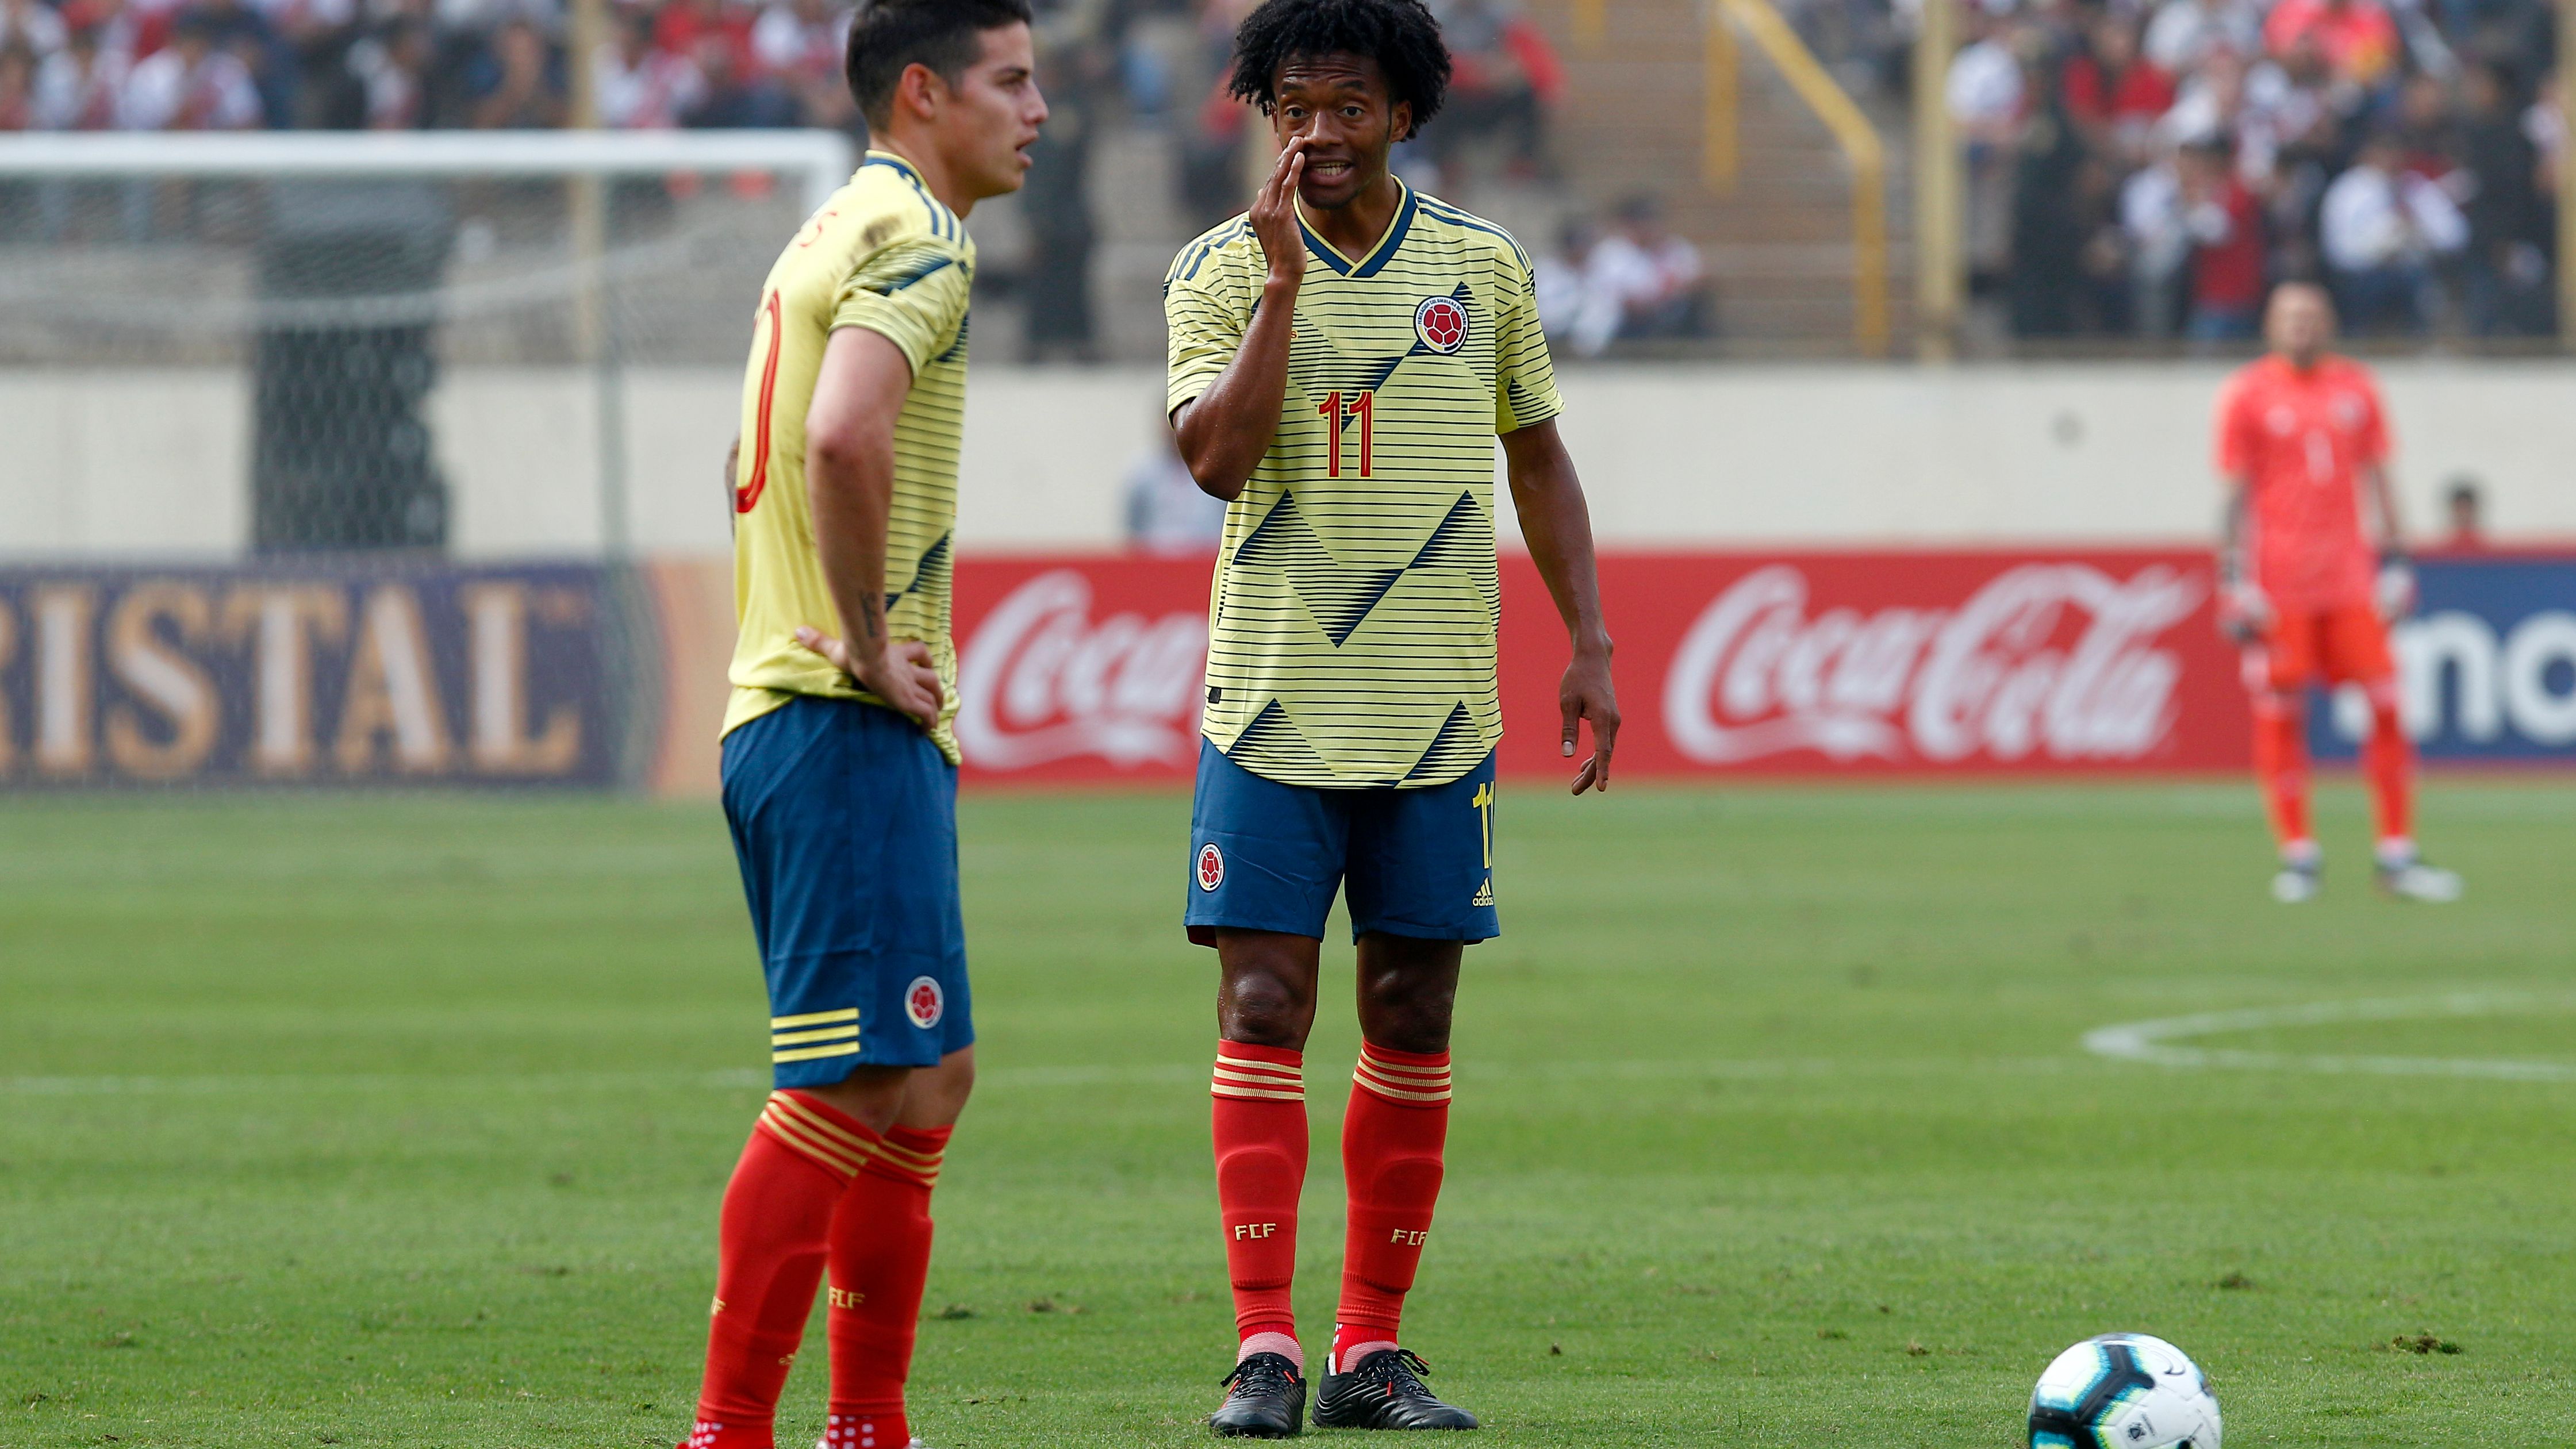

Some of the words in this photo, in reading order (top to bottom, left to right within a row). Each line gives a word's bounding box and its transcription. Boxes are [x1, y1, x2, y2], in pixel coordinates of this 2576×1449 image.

[1318, 390, 1375, 479] 11
[0, 579, 582, 779] ISTAL
[1661, 563, 2212, 766] Coca-Cola
[1472, 895, 1494, 906] adidas
[1235, 1223, 1276, 1240] FCF
[1391, 1228, 1427, 1246] FCF
